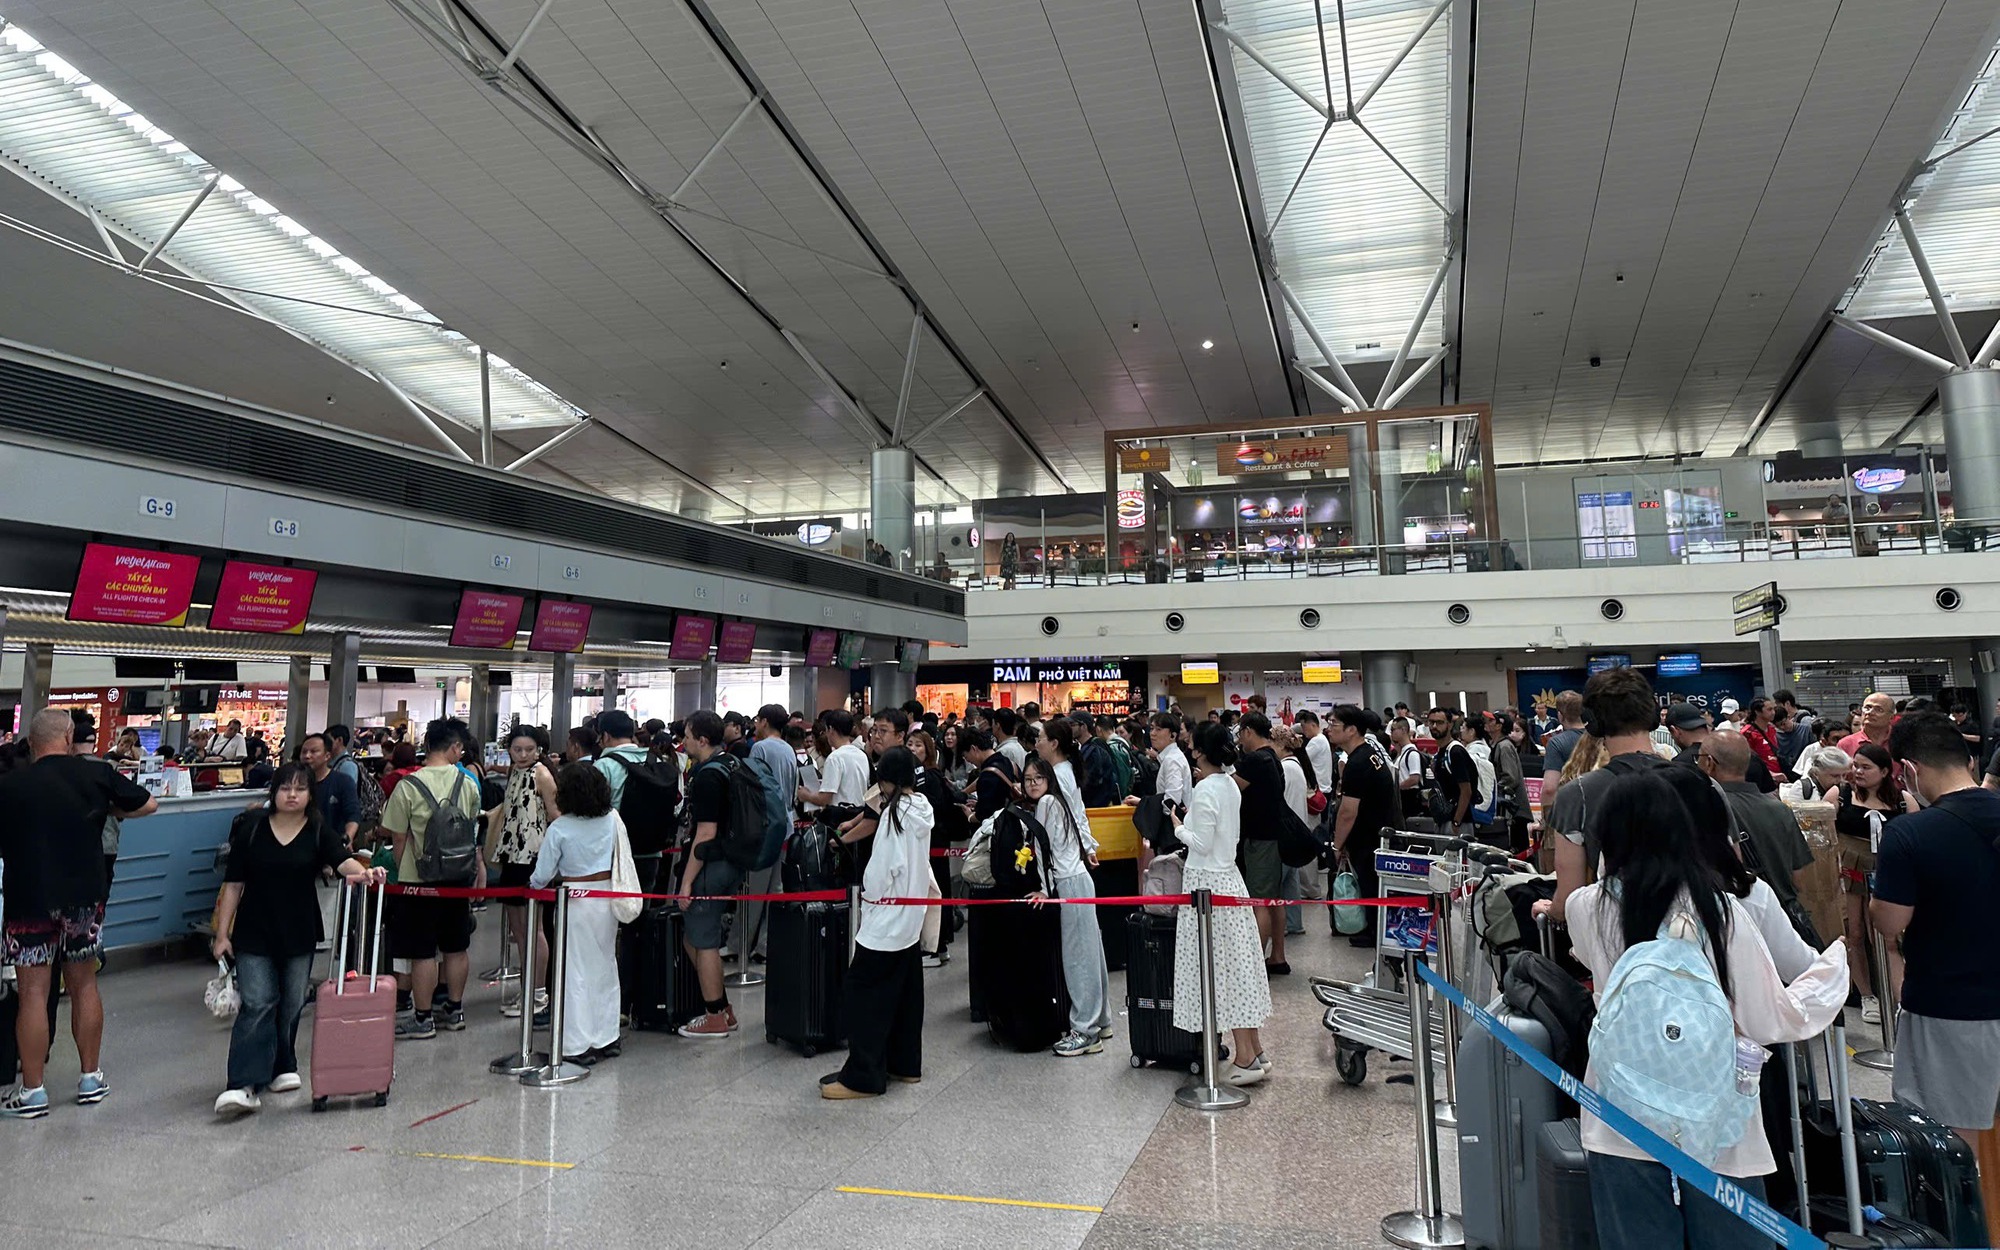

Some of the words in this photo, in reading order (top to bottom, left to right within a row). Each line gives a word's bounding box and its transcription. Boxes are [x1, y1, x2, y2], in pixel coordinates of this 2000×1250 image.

[1245, 463, 1283, 472] Restaurant
[1294, 460, 1320, 468] Coffee
[146, 498, 173, 516] G-9
[274, 519, 296, 535] G-8
[494, 556, 509, 569] G-7
[566, 567, 579, 579] G-6
[114, 594, 138, 602] FLIGHTS
[138, 596, 166, 604] CHECK-IN
[994, 667, 1031, 682] PAM
[1039, 667, 1064, 681] PHỞ
[1067, 667, 1091, 682] VIỆT
[1094, 669, 1121, 679] NAM
[227, 690, 252, 699] STORE
[1653, 691, 1708, 707] irles
[403, 886, 419, 896] ACV
[1463, 996, 1475, 1018] ACV
[1559, 1069, 1578, 1097] ACV
[1714, 1177, 1745, 1215] ACV
